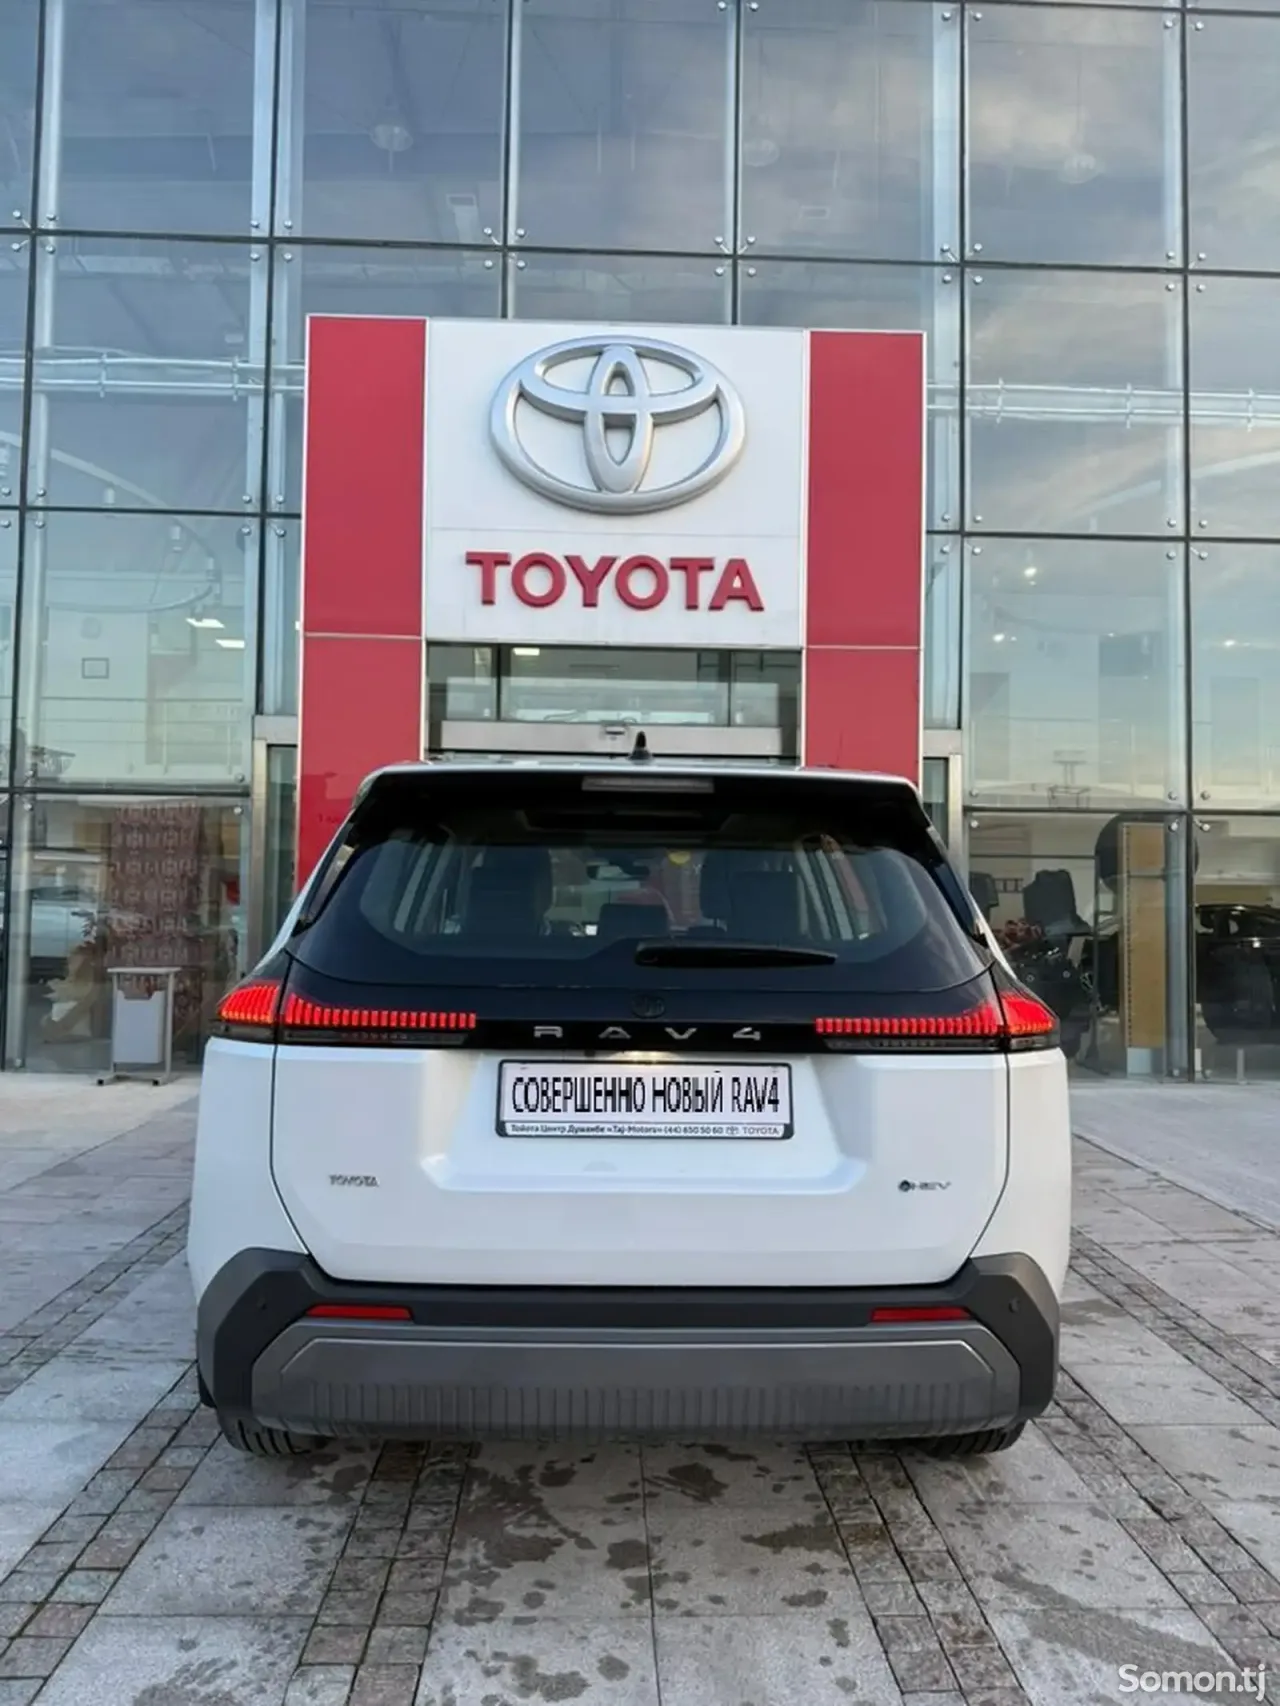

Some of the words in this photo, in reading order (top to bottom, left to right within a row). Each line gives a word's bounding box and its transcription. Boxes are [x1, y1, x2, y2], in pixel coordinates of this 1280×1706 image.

[465, 551, 764, 612] TOYOTA
[533, 1025, 761, 1041] RAV4
[511, 1076, 646, 1112] СОВЕРШЕННО
[652, 1069, 723, 1113] НОВЫЙ
[731, 1076, 780, 1112] RAV4
[743, 1127, 779, 1135] TOYOTA
[329, 1174, 379, 1187] TOYOTA
